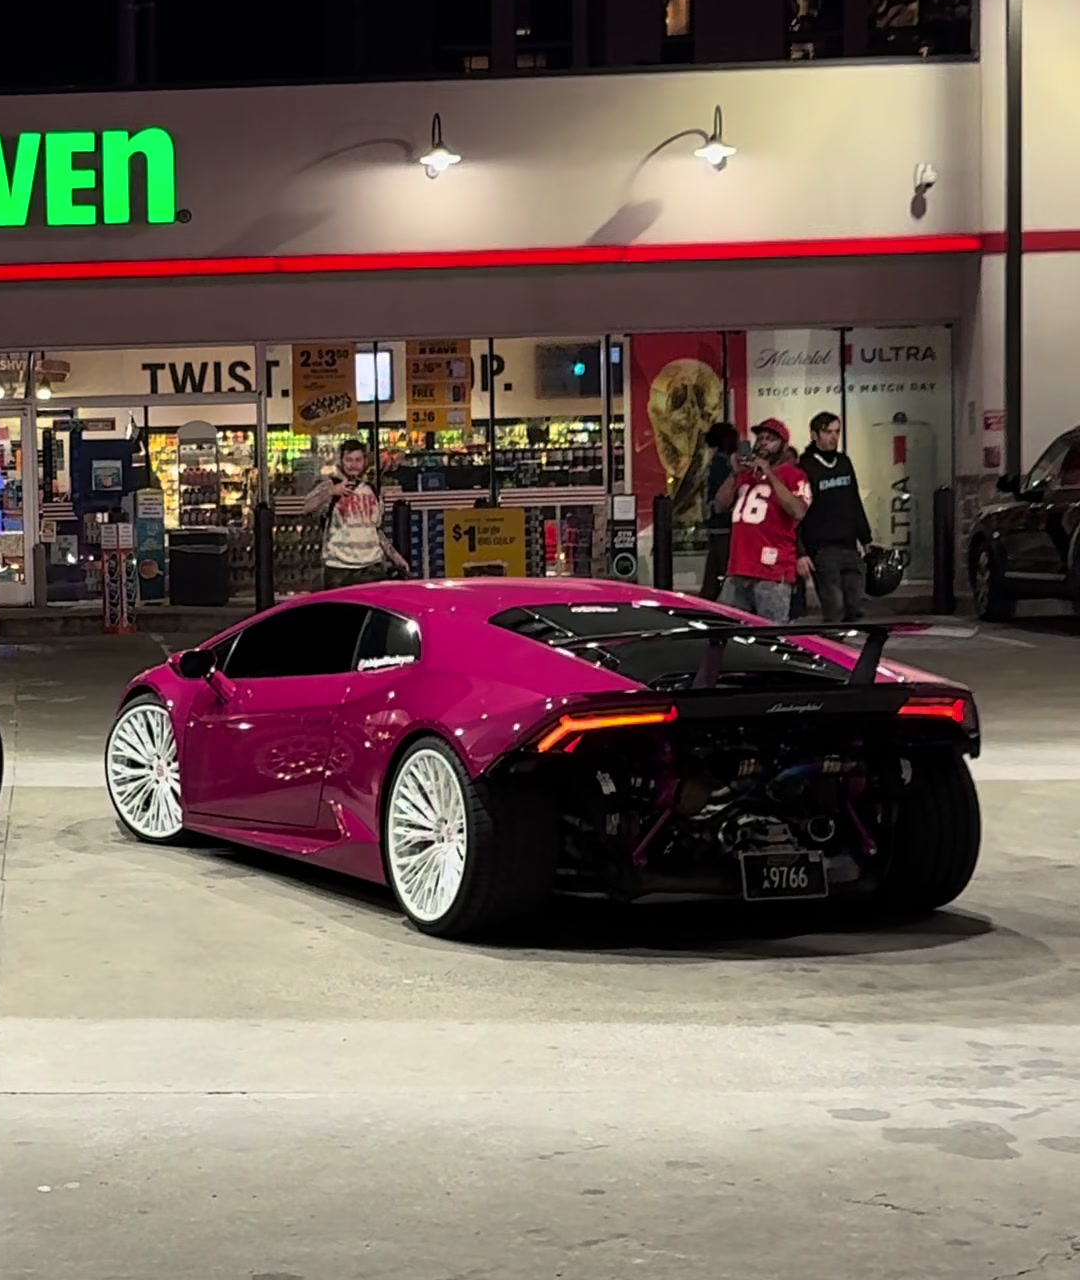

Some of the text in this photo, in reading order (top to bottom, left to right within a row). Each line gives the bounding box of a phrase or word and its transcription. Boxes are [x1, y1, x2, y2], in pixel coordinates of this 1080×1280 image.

[300, 349, 311, 368] 2
[860, 346, 936, 363] ULTRA
[758, 386, 798, 397] STOCK
[804, 386, 821, 395] UP
[860, 383, 904, 393] MATCH
[452, 524, 477, 553] $1
[770, 866, 809, 889] 9766
